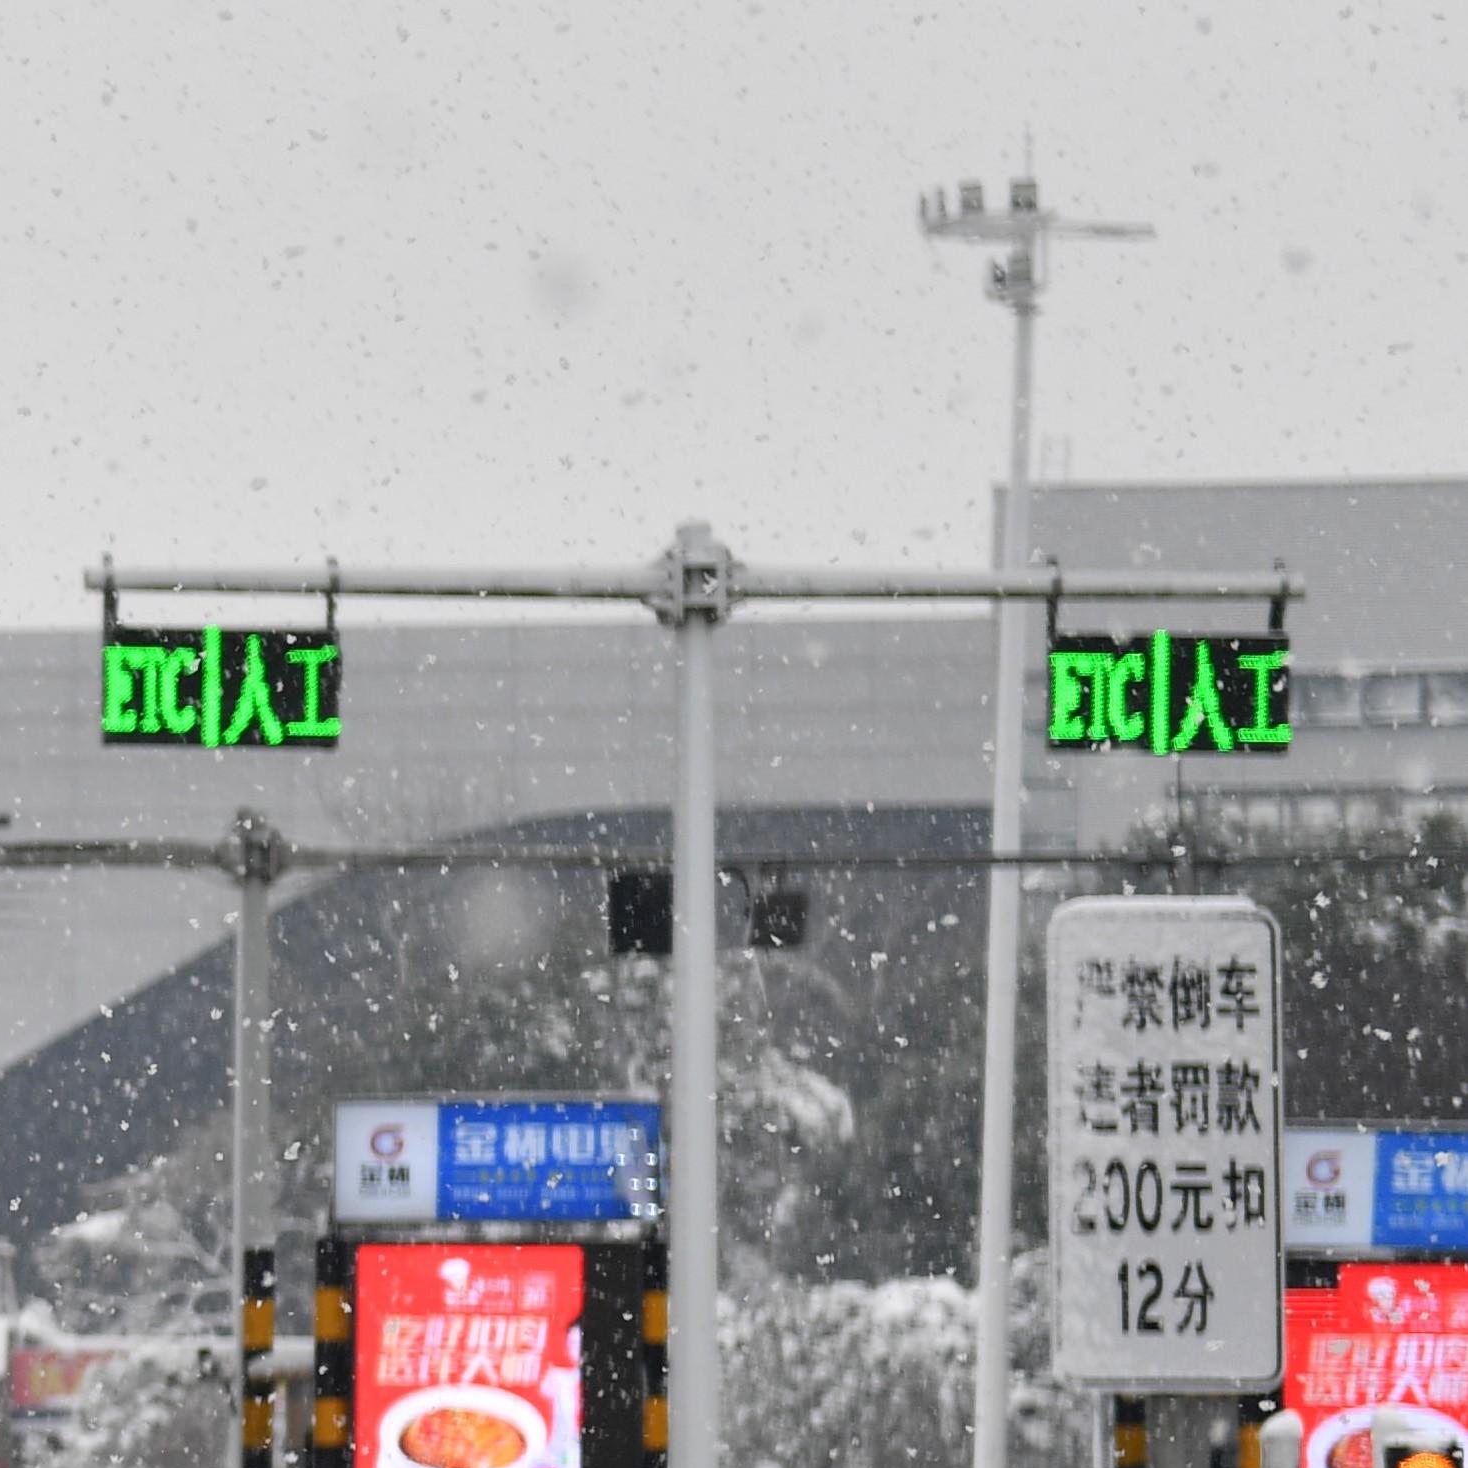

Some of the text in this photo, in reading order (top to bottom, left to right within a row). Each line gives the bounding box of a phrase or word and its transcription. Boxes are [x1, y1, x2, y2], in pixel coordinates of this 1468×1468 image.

[1076, 955, 1260, 1031] 严禁倒车
[1076, 1059, 1261, 1134] 违者罚款
[1071, 1156, 1265, 1234] 200元扣
[1117, 1259, 1214, 1334] 12分
